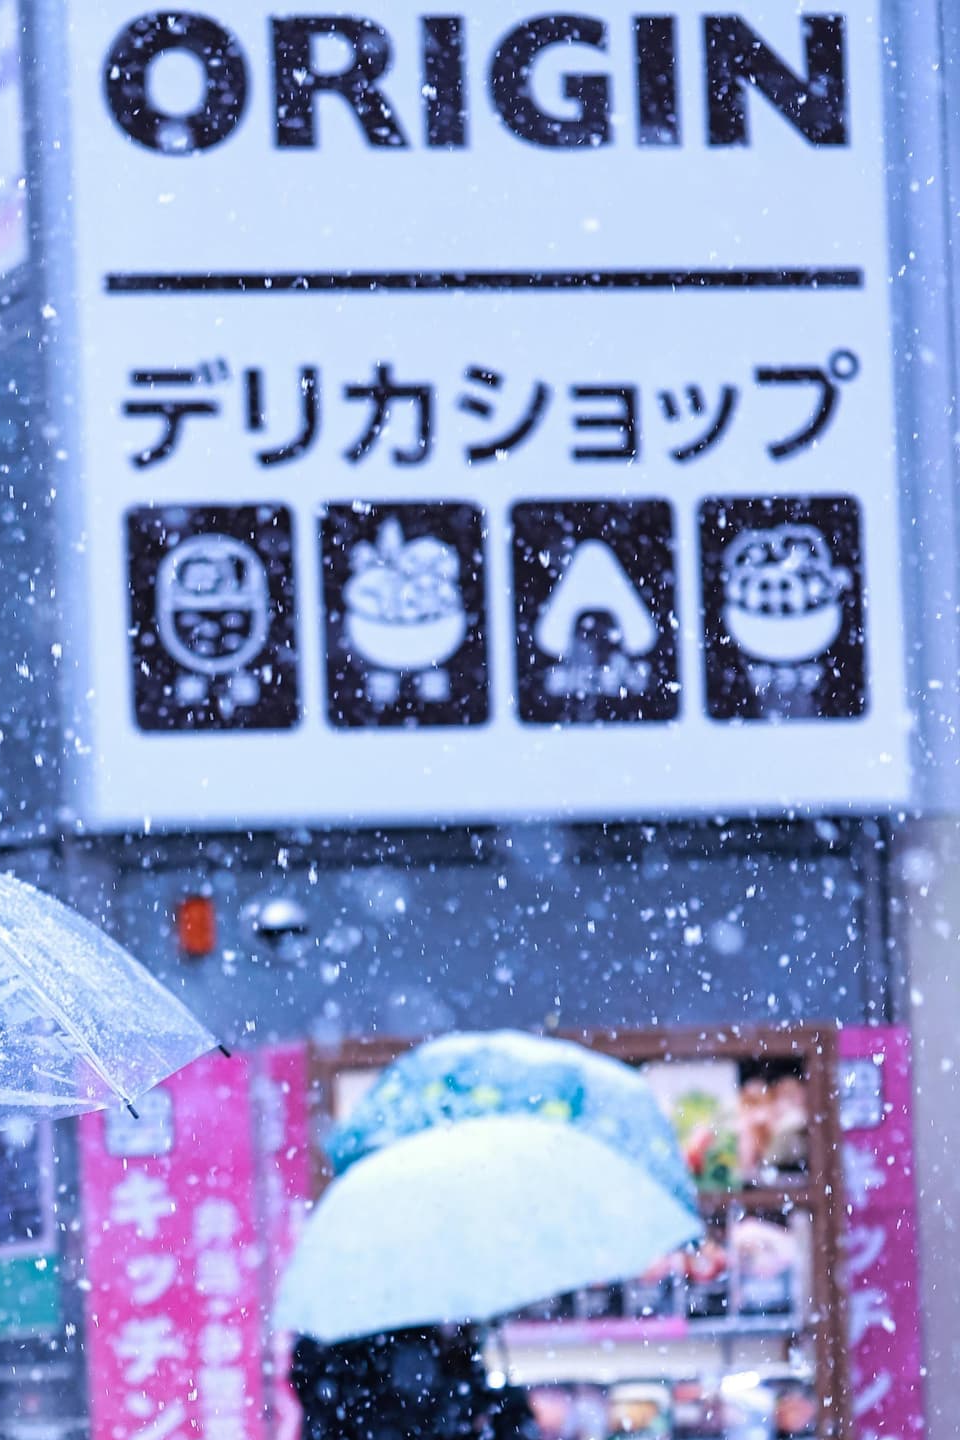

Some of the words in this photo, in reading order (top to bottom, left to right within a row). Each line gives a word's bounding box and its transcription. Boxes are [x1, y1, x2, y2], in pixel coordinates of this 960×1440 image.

[101, 13, 852, 155] ORIGIN
[123, 350, 860, 469] デリカショップ
